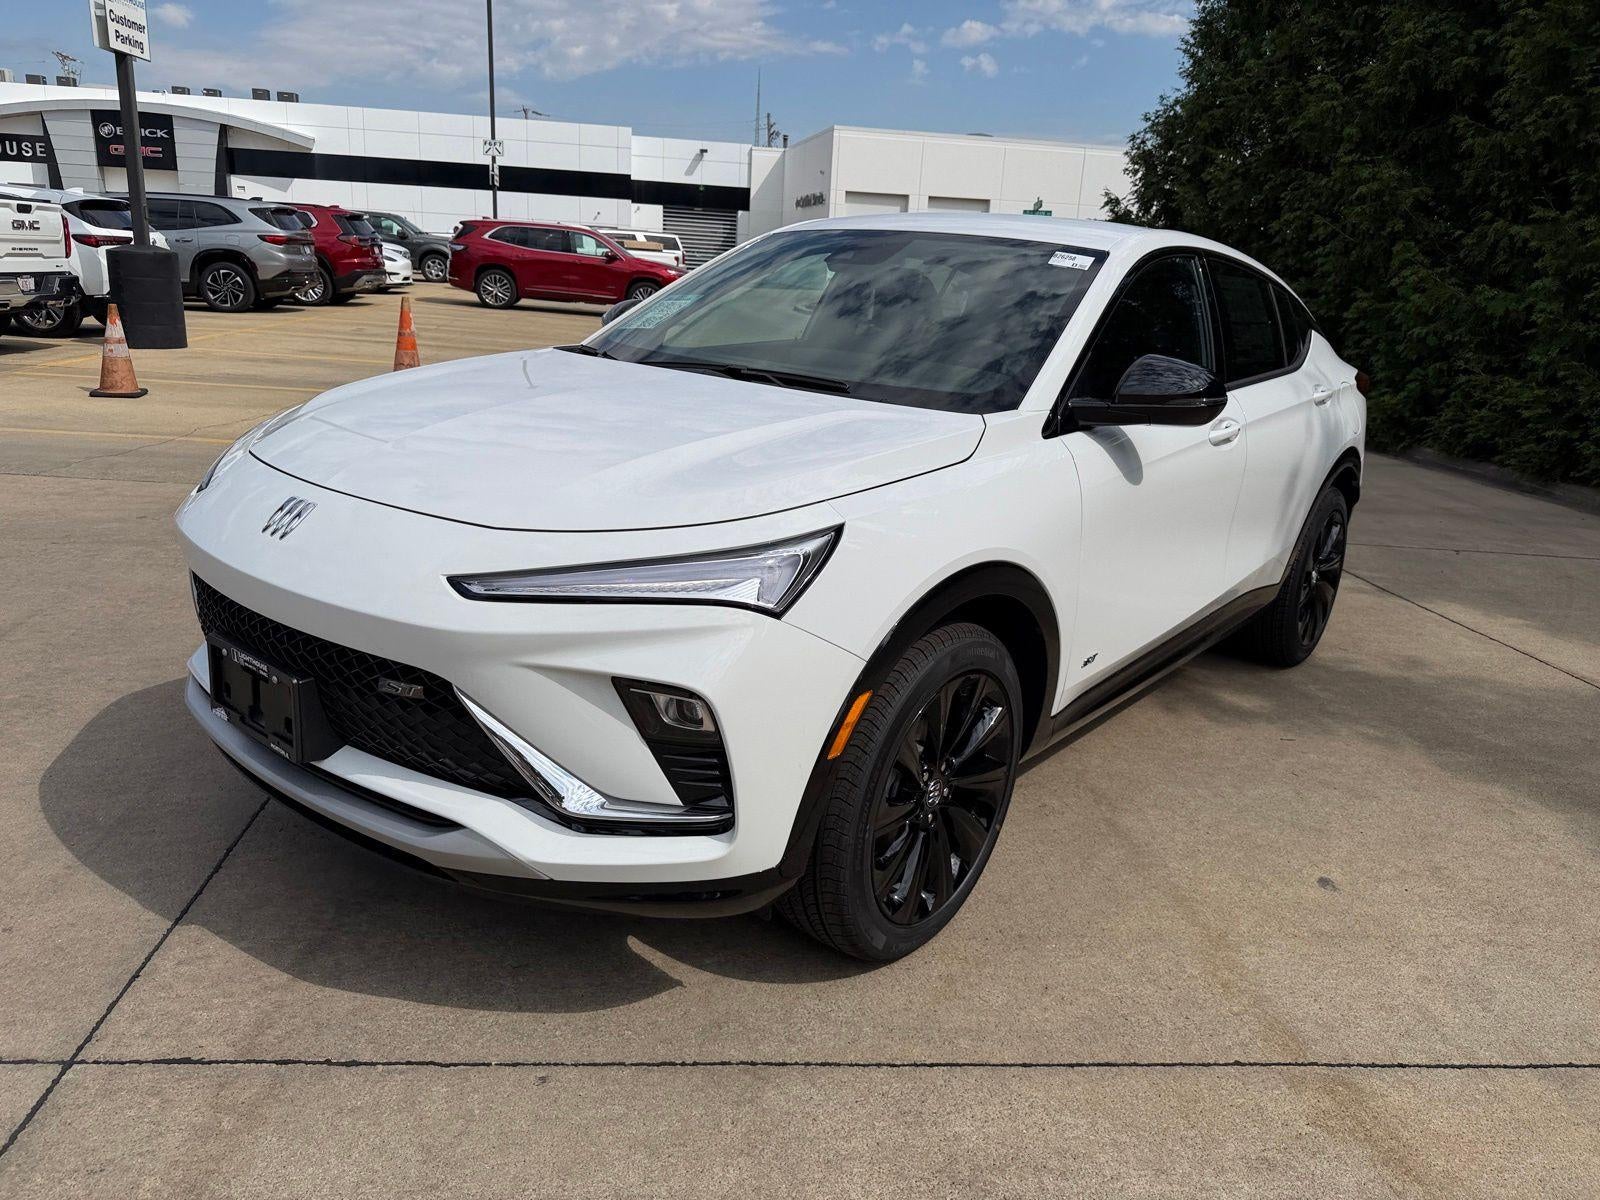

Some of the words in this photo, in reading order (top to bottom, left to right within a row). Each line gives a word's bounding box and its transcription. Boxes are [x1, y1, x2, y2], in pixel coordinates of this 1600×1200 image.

[109, 8, 146, 34] Customer
[114, 29, 145, 54] Parking
[116, 127, 170, 138] BICK
[0, 139, 47, 157] USE
[109, 144, 162, 158] GC
[12, 219, 40, 231] GMC
